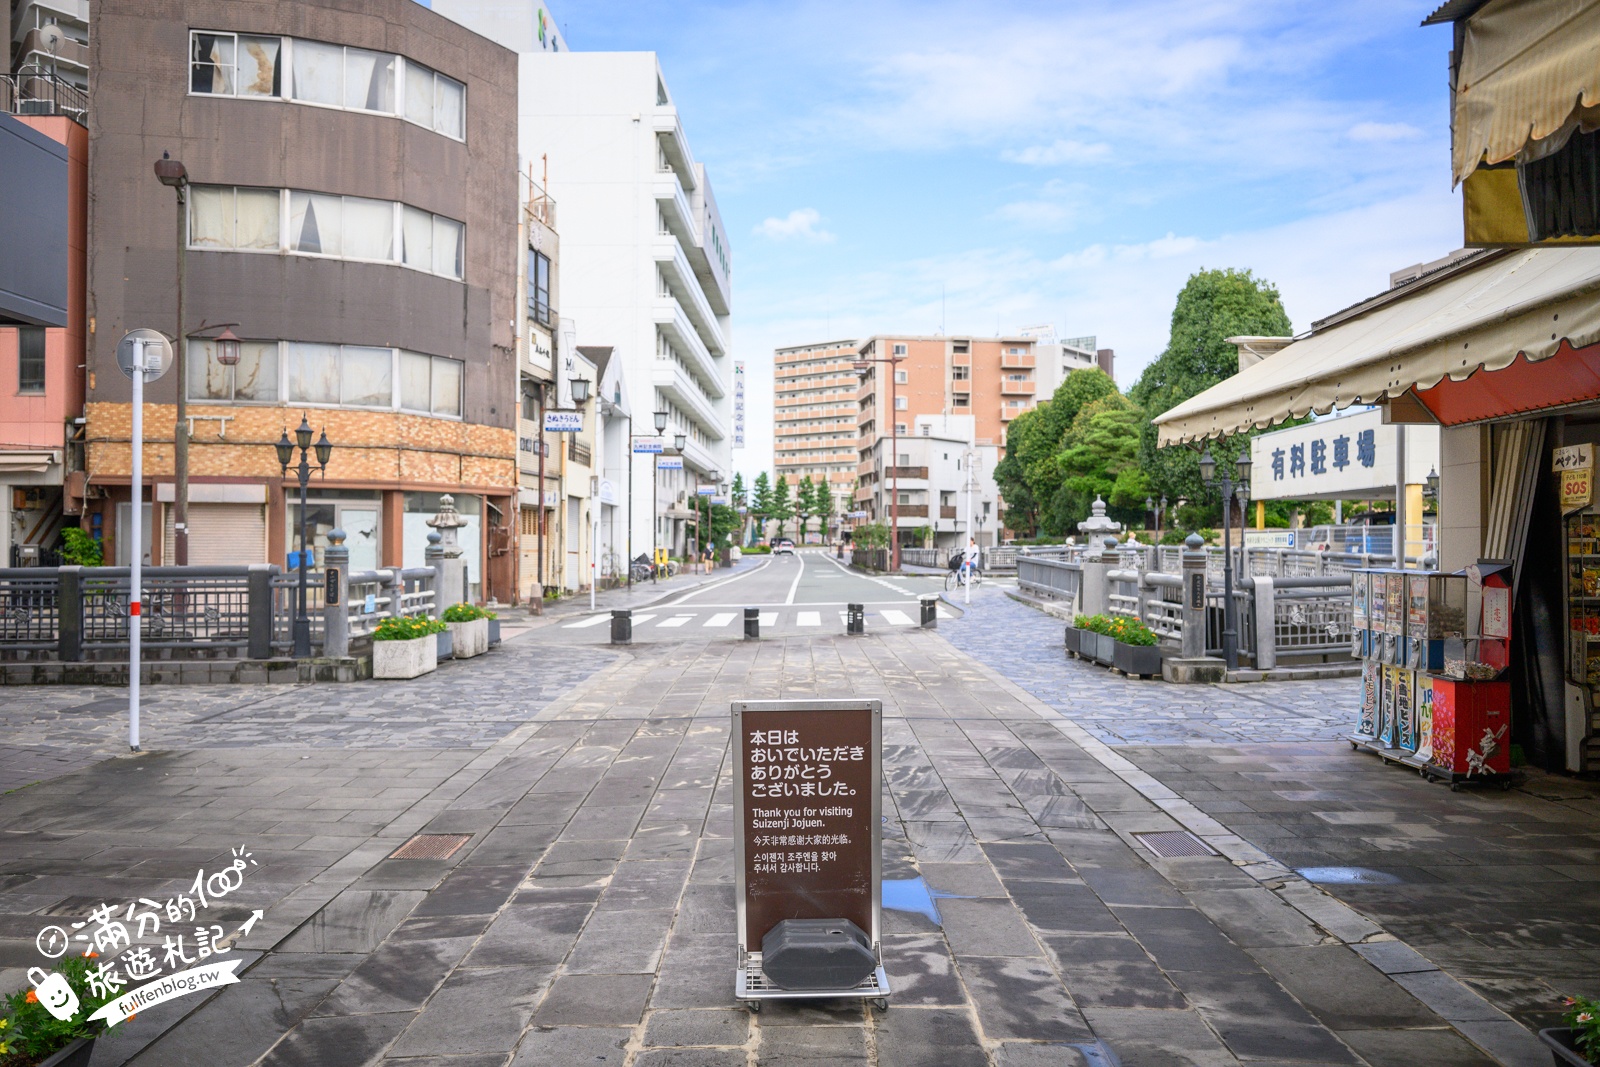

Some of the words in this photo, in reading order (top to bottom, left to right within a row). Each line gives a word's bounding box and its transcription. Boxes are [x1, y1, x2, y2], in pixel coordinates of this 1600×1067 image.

[1271, 429, 1376, 482] 有料駐車場
[1565, 480, 1587, 495] SOS
[1423, 689, 1433, 704] JR
[750, 730, 799, 745] 本日は
[751, 746, 864, 763] おいでいただき
[751, 764, 831, 780] ありがとう
[752, 781, 856, 797] ございました。
[752, 808, 781, 817] Thank
[784, 810, 800, 820] you
[803, 807, 817, 816] for
[820, 806, 853, 817] visiting
[752, 819, 789, 830] Suizenji
[792, 818, 825, 829] Jojuen.
[753, 834, 851, 846] 今天非常感谢大家的光临。
[753, 852, 784, 862] 스이젠지
[821, 851, 837, 862] 찾아
[753, 863, 777, 873] 주셔서
[780, 862, 821, 873] 감사합니다.
